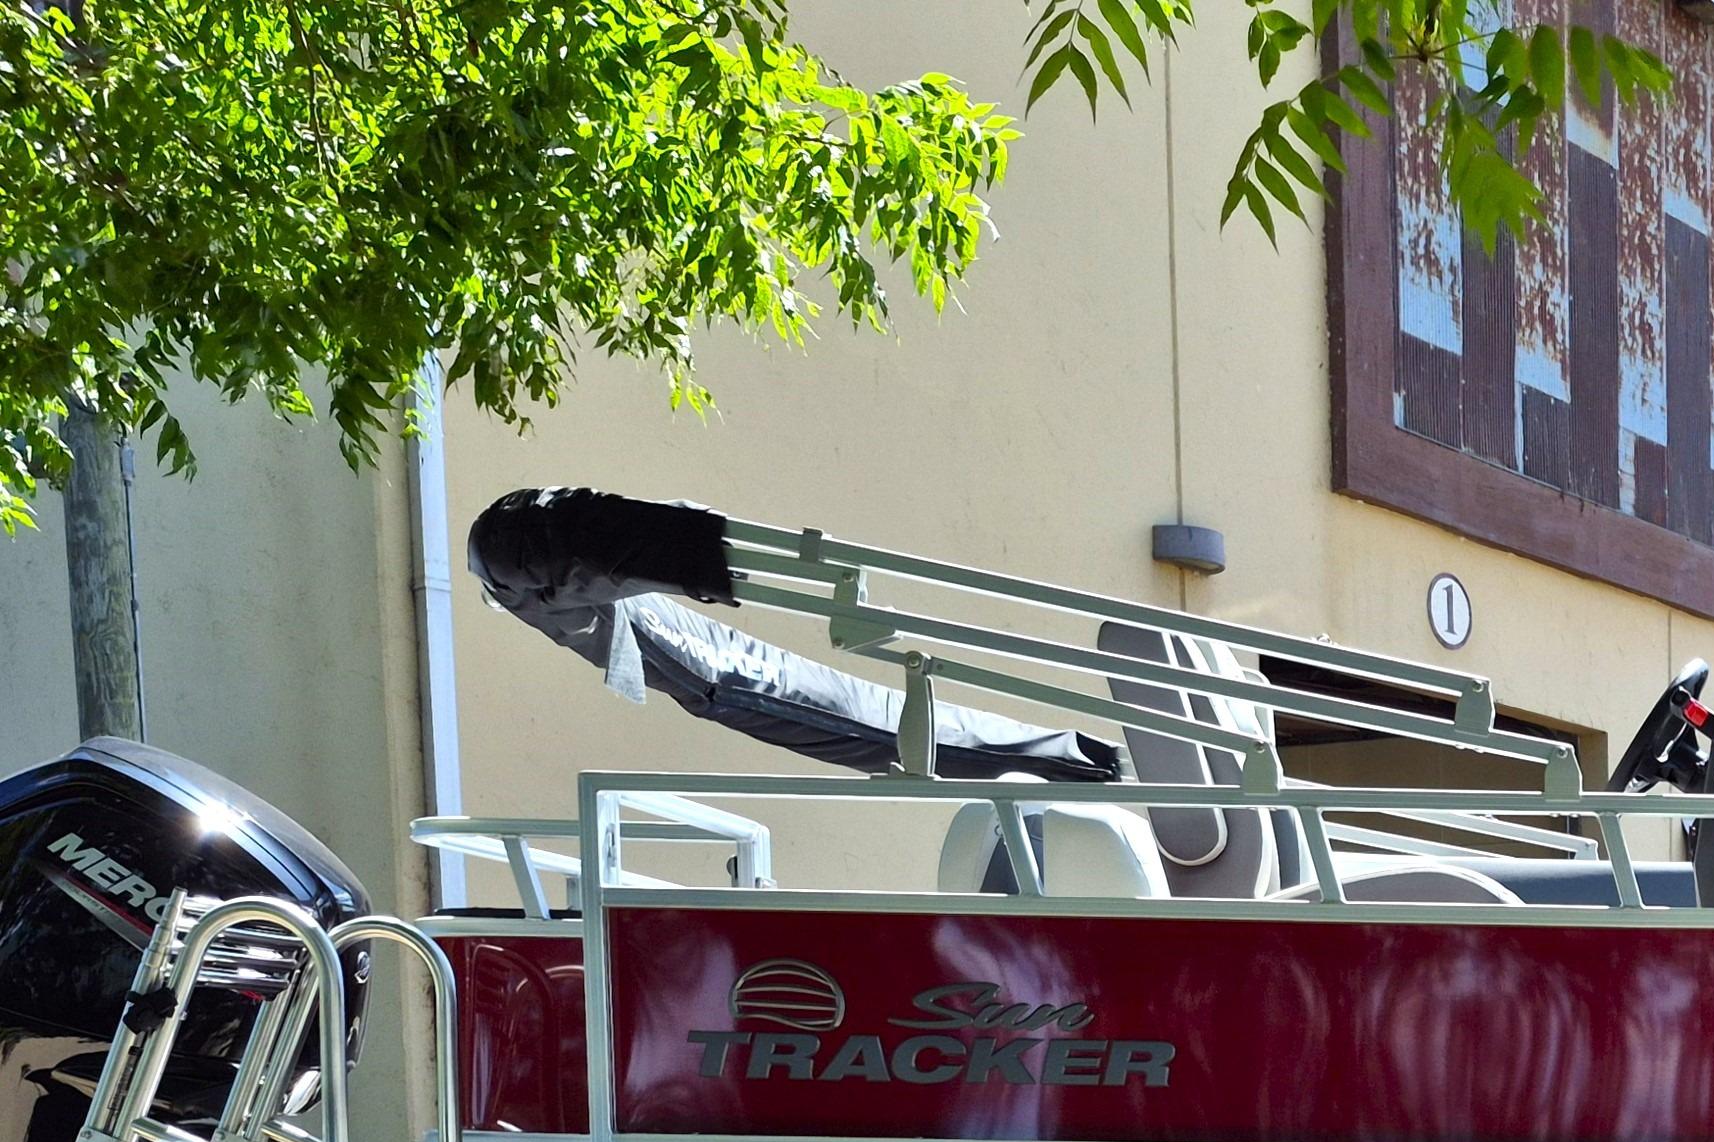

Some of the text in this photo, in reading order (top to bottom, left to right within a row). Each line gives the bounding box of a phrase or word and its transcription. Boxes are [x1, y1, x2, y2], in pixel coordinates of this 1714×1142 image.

[1442, 583, 1458, 635] 1
[888, 981, 1095, 1031] Sun
[686, 1030, 1176, 1087] TRACKER
